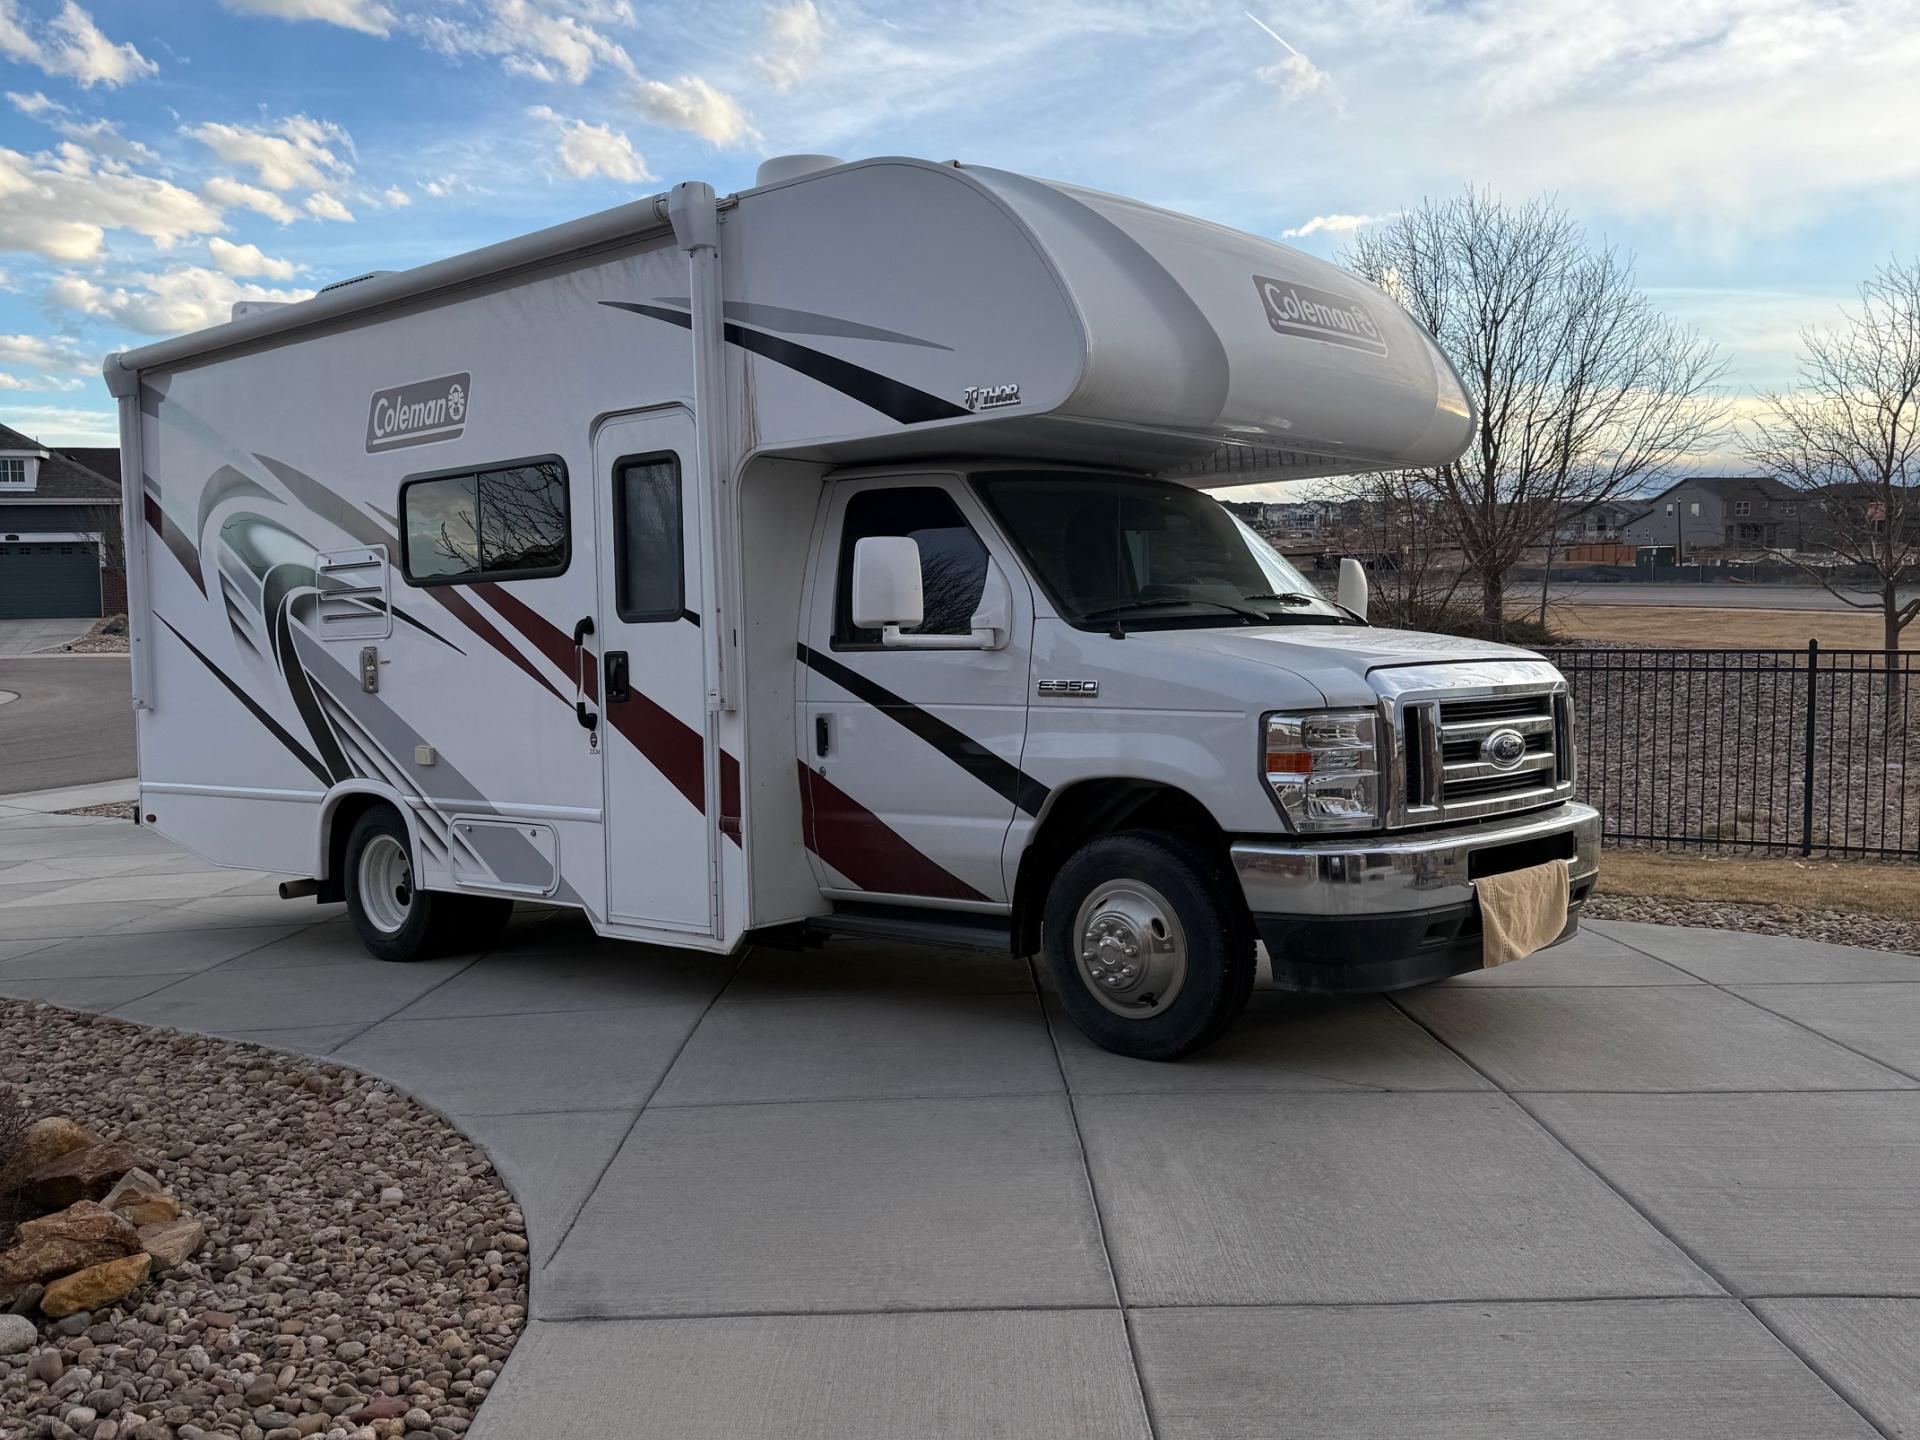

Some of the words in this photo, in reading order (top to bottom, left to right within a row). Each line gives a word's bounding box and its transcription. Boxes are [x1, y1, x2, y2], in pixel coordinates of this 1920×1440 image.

[1264, 283, 1360, 334] Coleman
[979, 383, 1020, 405] THOR
[373, 395, 447, 438] Coleman
